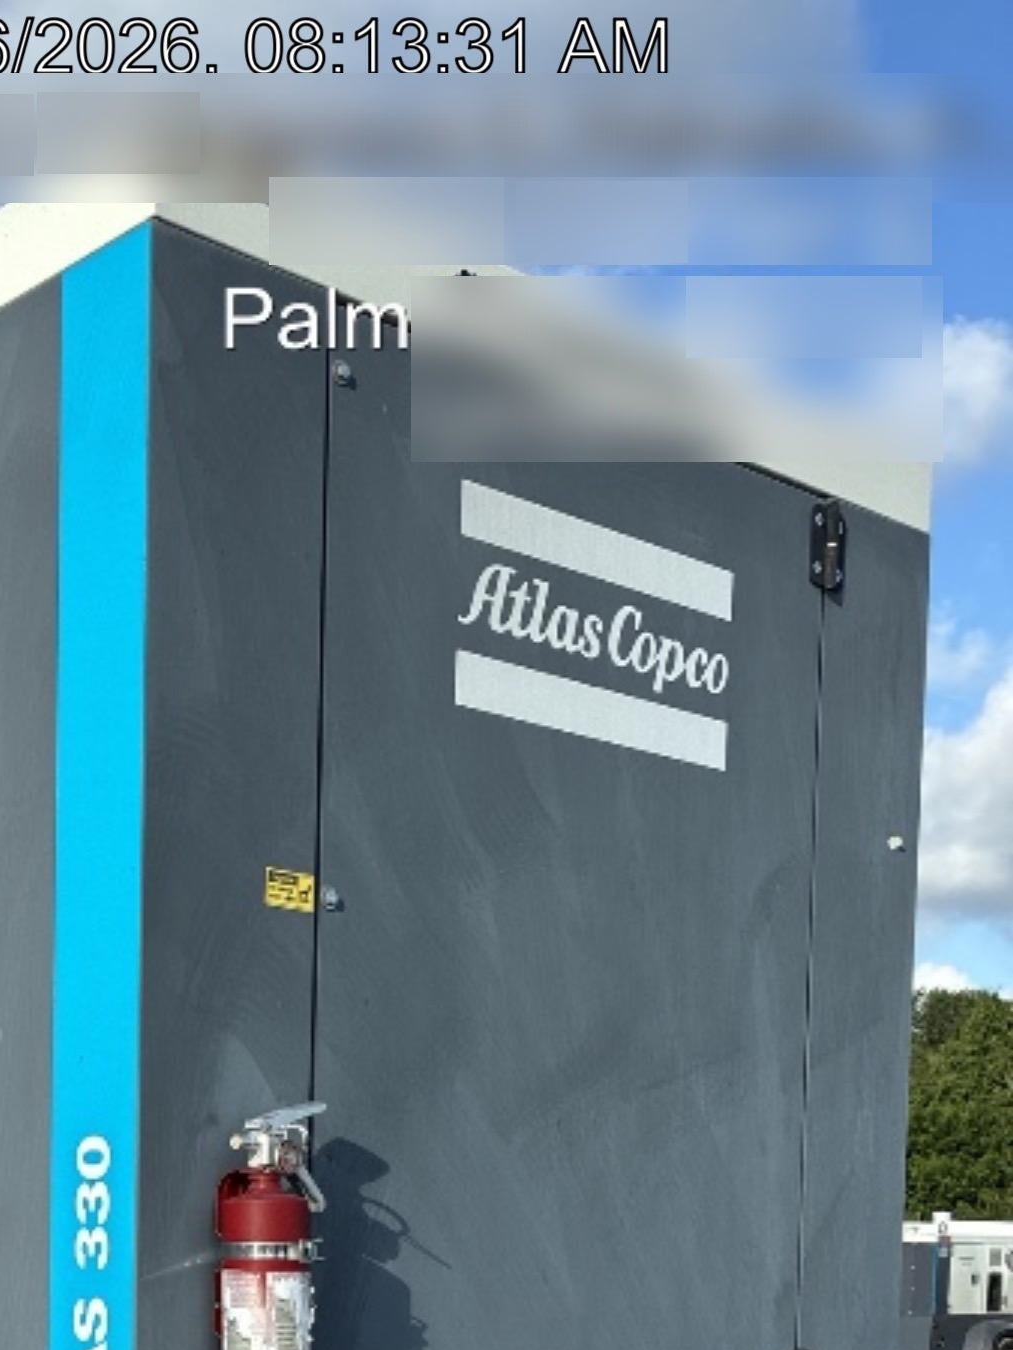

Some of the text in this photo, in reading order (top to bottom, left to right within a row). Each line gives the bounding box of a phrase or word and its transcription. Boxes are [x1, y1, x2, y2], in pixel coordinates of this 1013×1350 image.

[458, 563, 730, 694] Atlas Copco
[75, 1135, 112, 1270] 330
